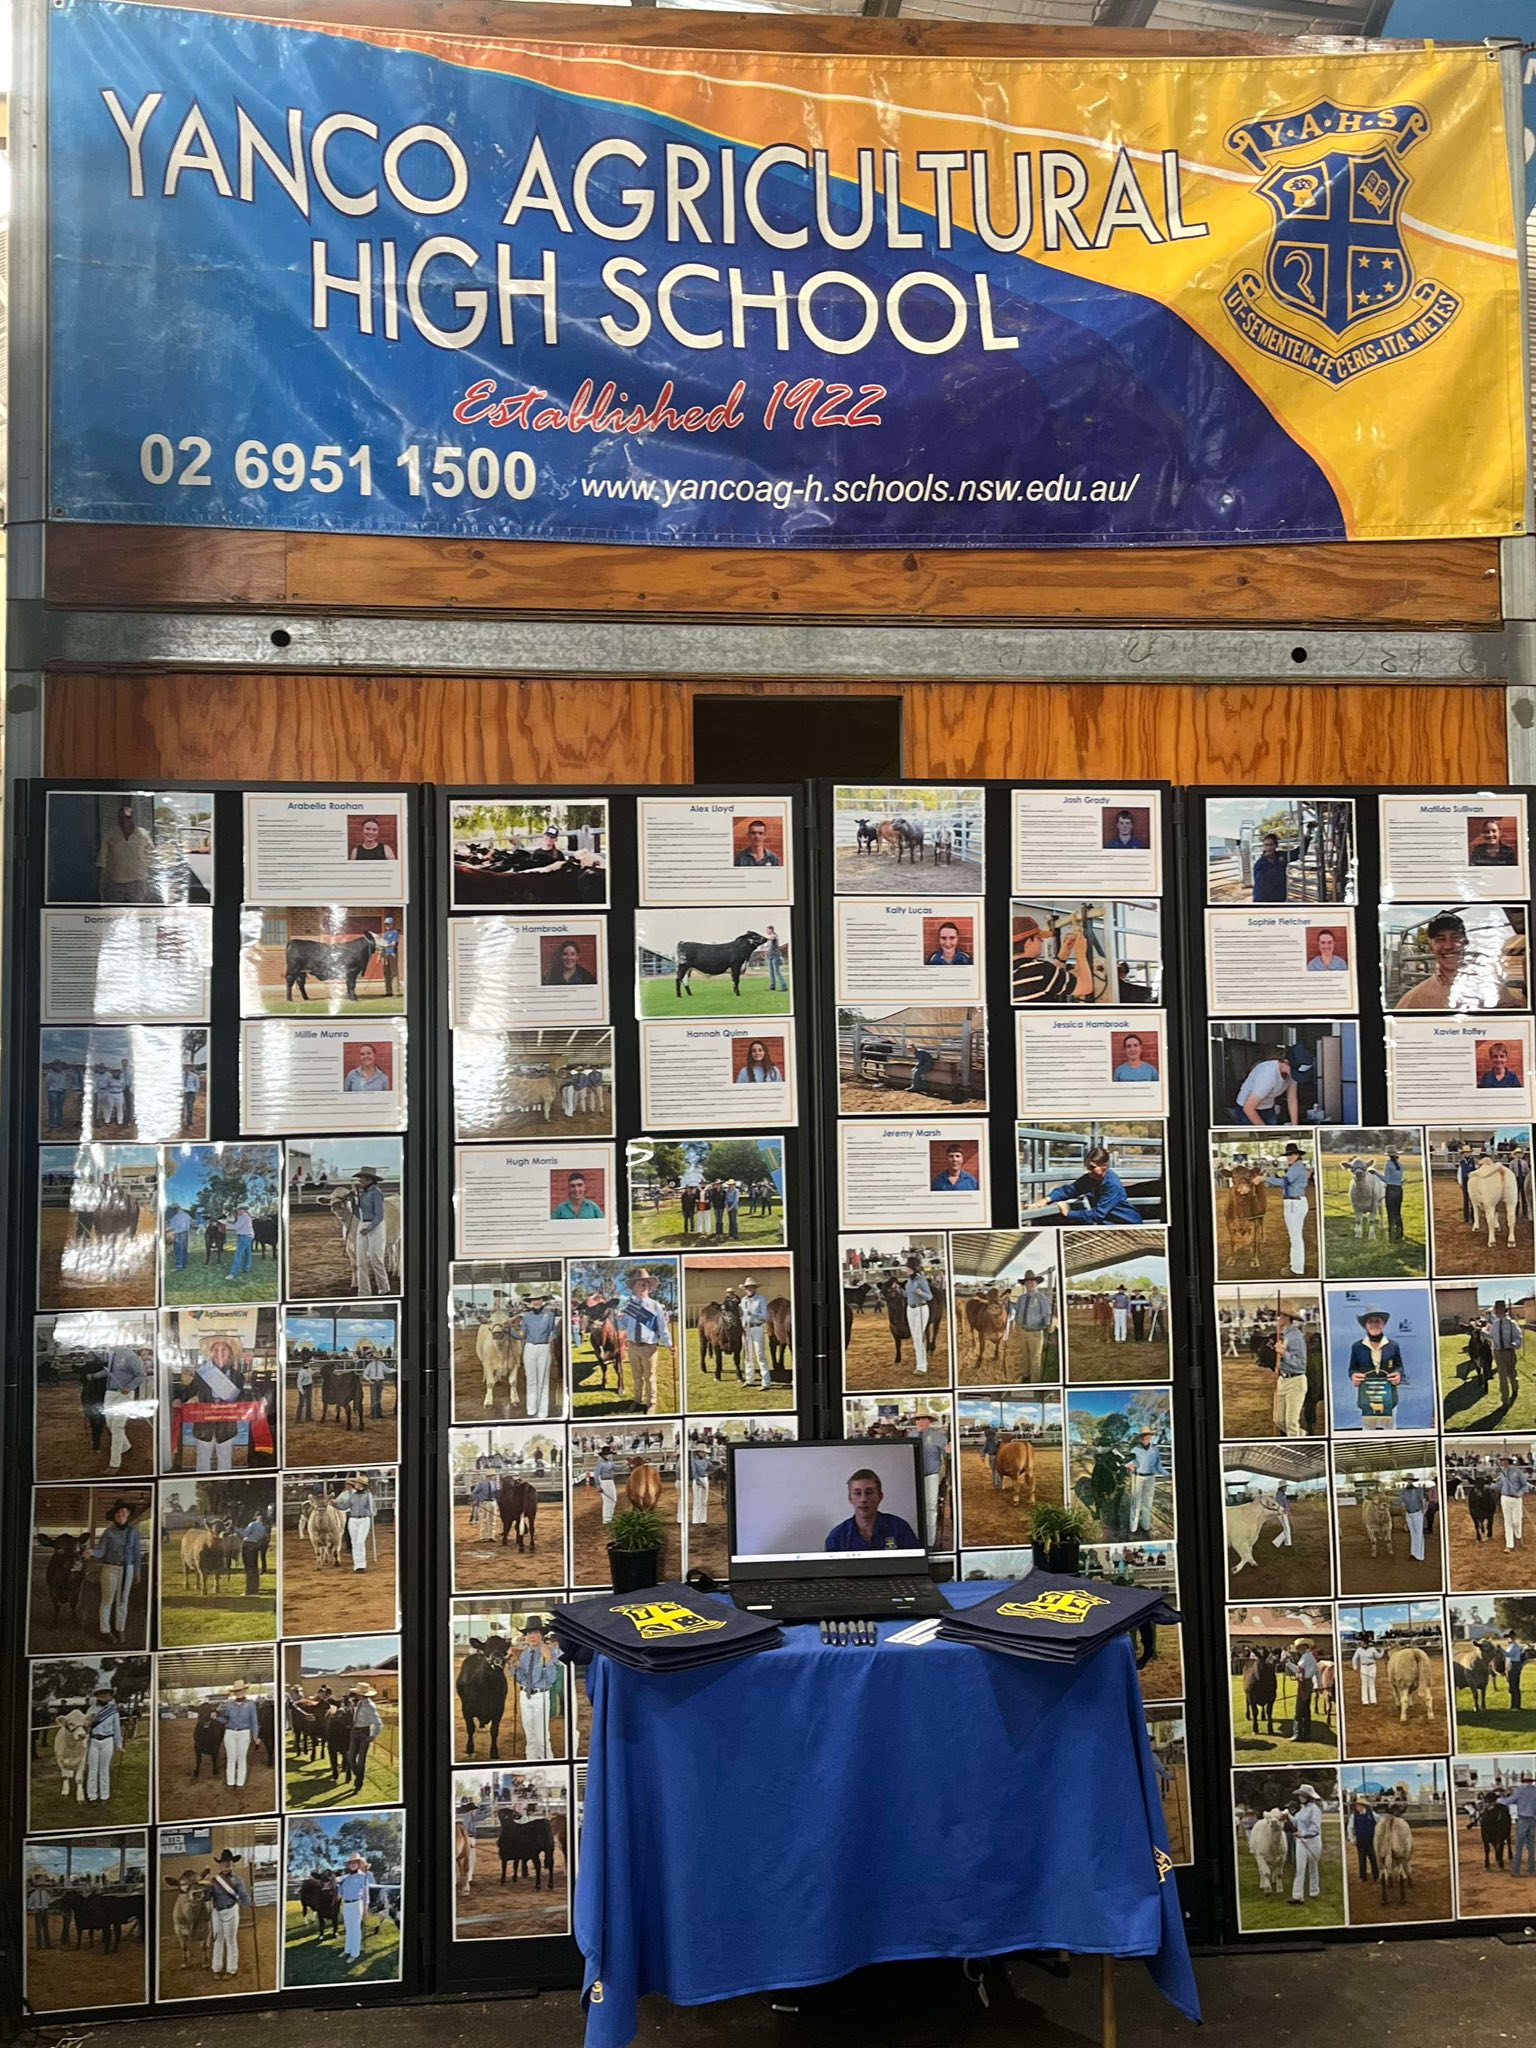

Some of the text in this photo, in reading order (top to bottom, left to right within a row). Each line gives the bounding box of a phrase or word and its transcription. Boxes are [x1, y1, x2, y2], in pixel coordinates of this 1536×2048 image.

[101, 89, 1210, 252] YANCO AGRICULTURAL
[311, 236, 1020, 355] HIGH SCHOOL
[452, 378, 888, 434] Established 1922
[140, 433, 537, 500] 02 6951 1500
[581, 472, 1140, 507] www.yancoag-h.schools.nsw.edu.au/
[1064, 796, 1111, 805] Josh Grady
[287, 802, 364, 811] Arabella Roohan
[690, 805, 736, 815] Alex Lloyd
[1420, 805, 1484, 813] Matilda Sullivan
[908, 906, 932, 914] Lucas
[1248, 918, 1312, 927] Sophie Fletcher
[521, 925, 569, 933] Hambrook
[1052, 1020, 1130, 1029] Jessica Hambrook
[320, 1030, 350, 1038] Munro
[686, 1029, 749, 1038] Hannah Quinn
[1433, 1027, 1460, 1036] Xavier
[882, 1129, 942, 1139] Jeremy Marsh
[506, 1156, 558, 1167] Hugh Morris
